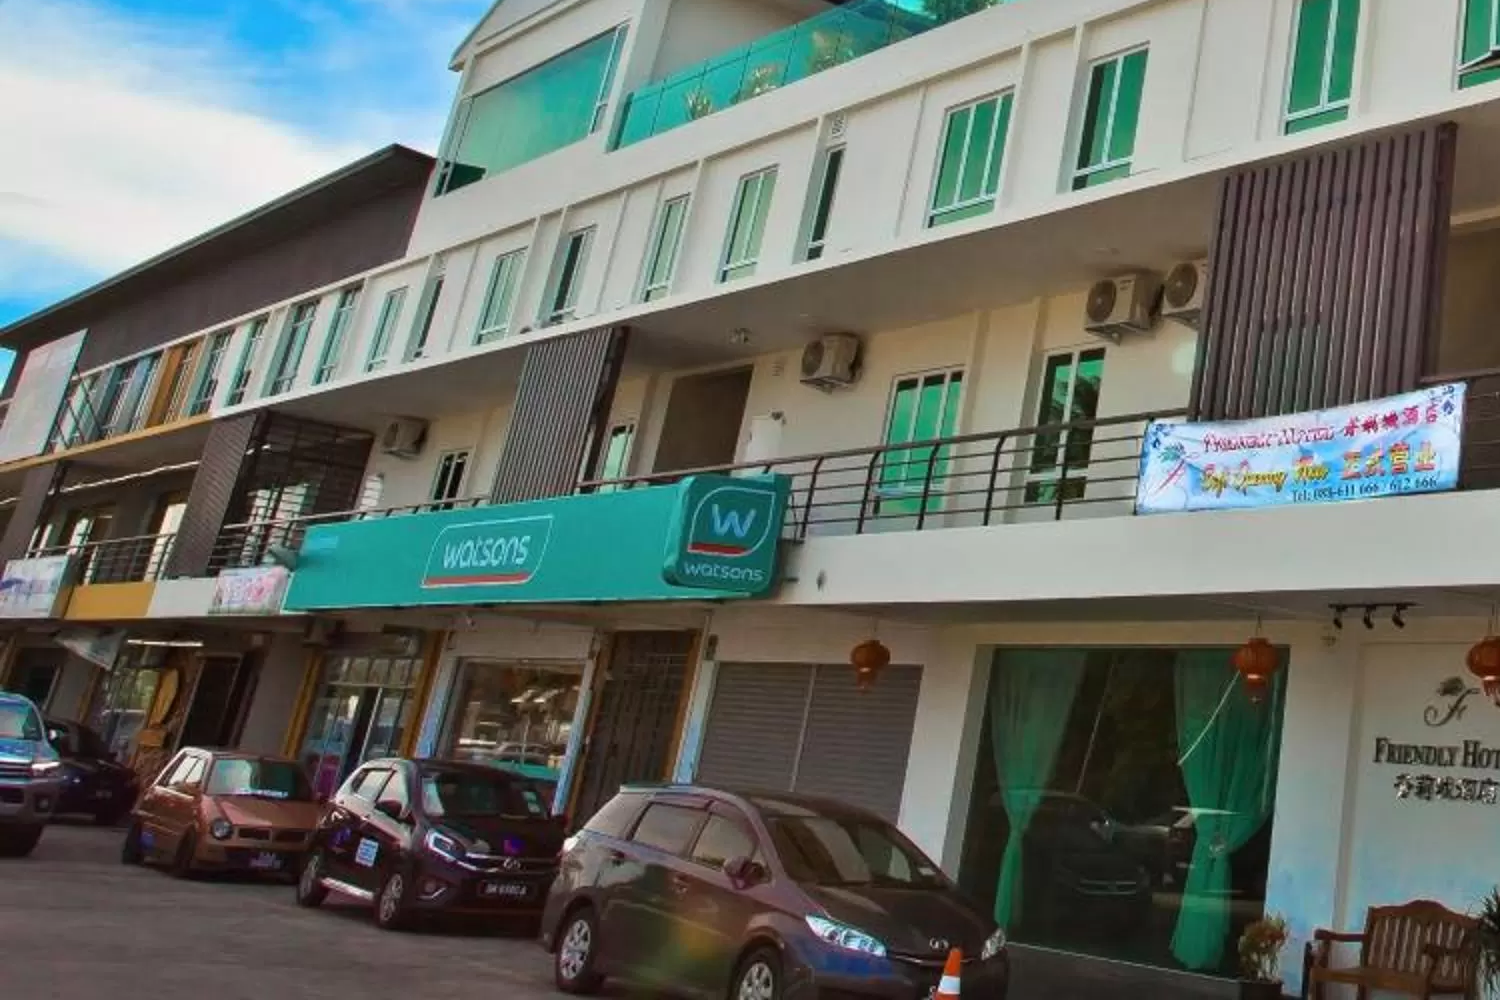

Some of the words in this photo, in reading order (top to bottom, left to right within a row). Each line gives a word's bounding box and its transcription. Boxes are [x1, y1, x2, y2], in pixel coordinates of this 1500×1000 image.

[443, 534, 531, 569] watsons
[683, 561, 766, 584] watsons
[1373, 737, 1461, 768] FRIENDLY
